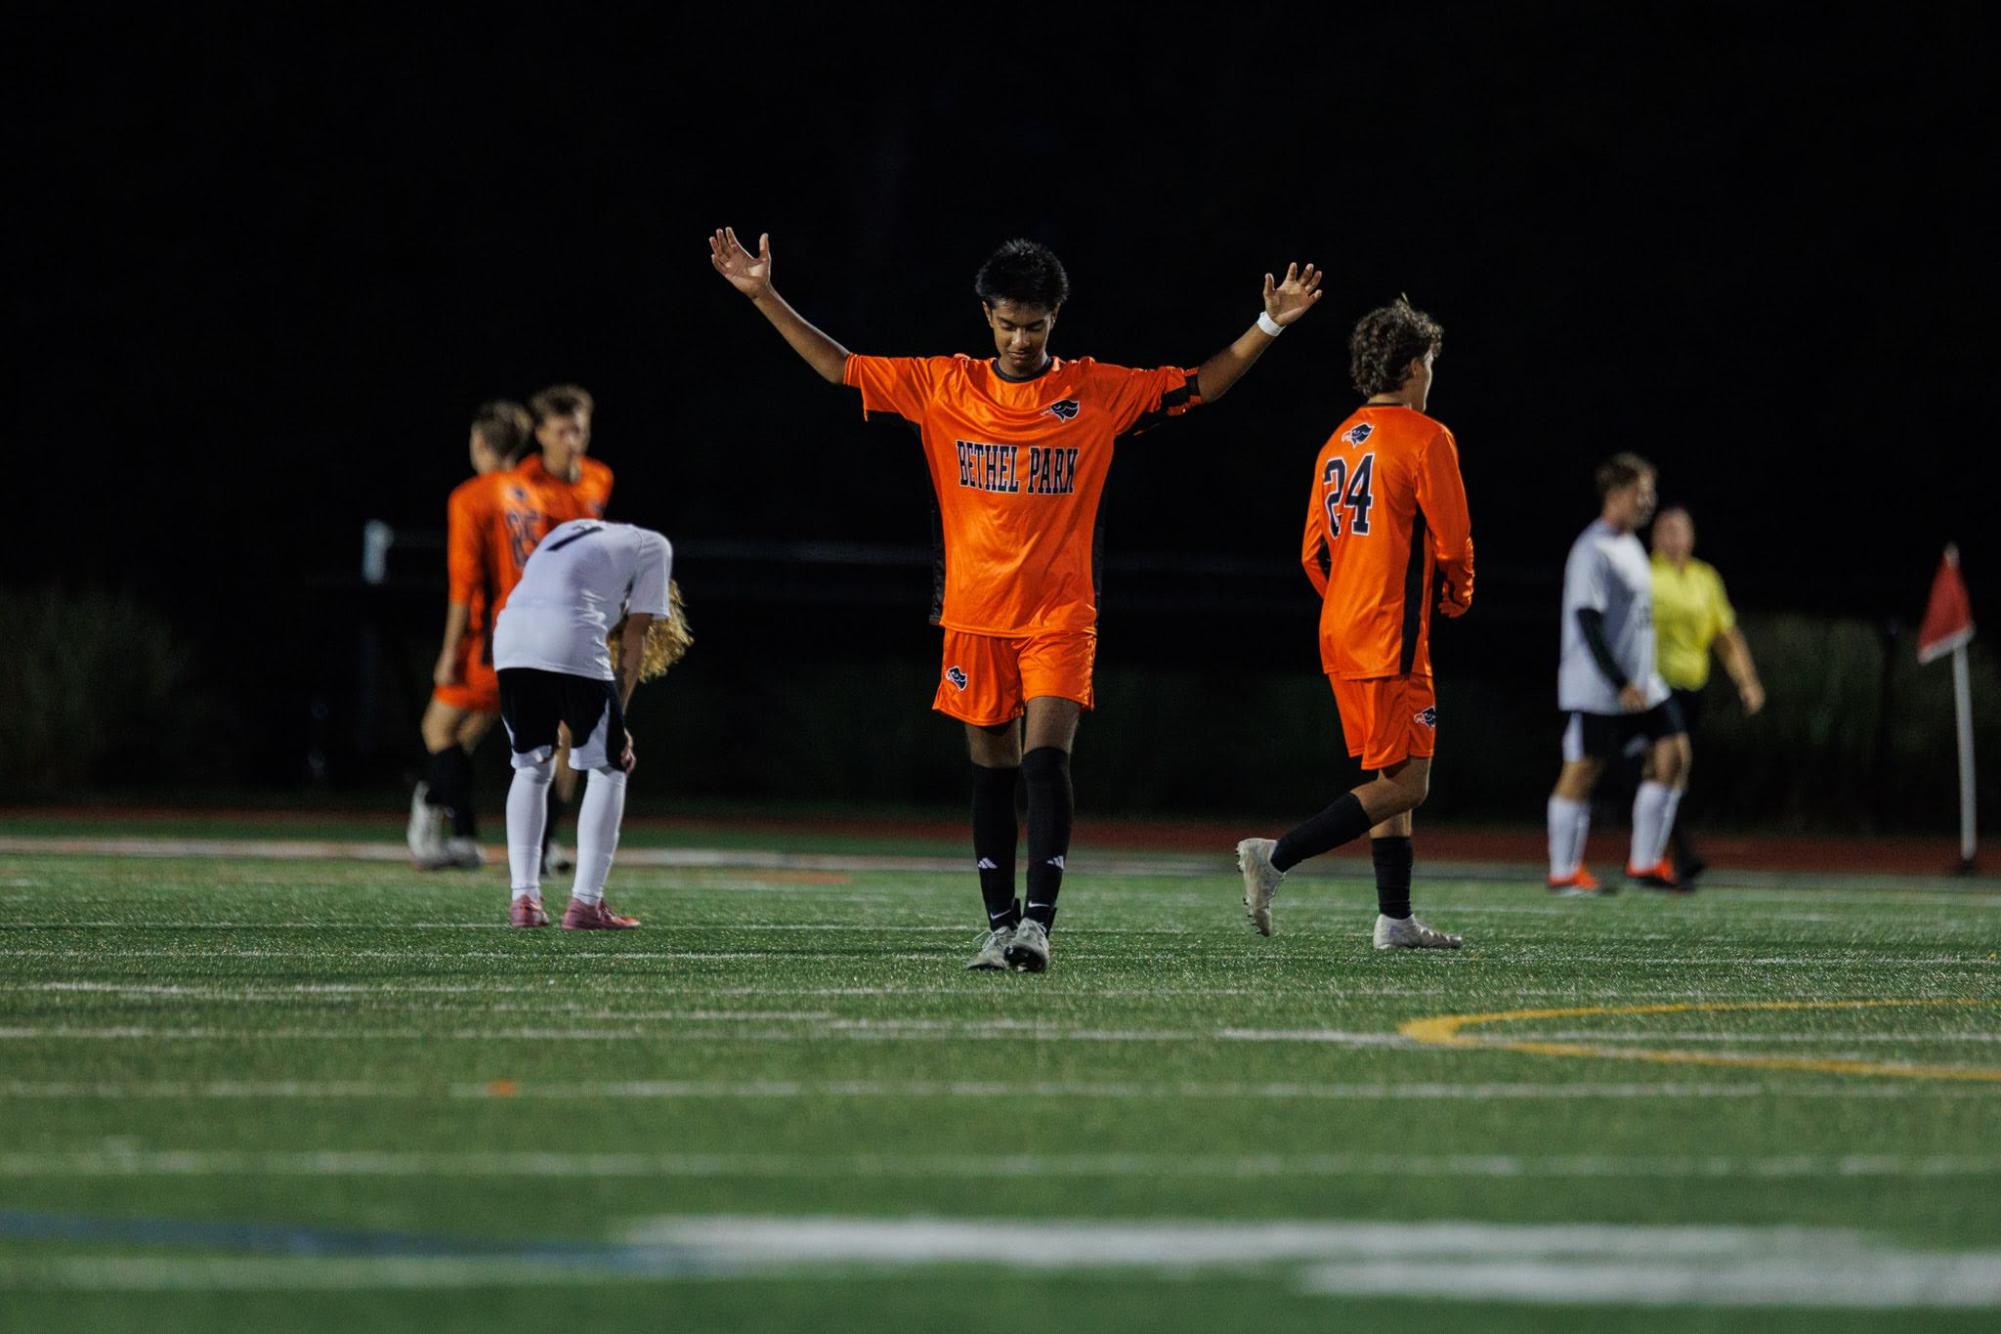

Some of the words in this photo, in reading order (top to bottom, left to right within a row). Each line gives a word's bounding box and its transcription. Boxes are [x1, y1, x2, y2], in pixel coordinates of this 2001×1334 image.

[955, 439, 1020, 494] BETHEL
[1027, 445, 1079, 494] PARK
[1322, 452, 1375, 539] 24
